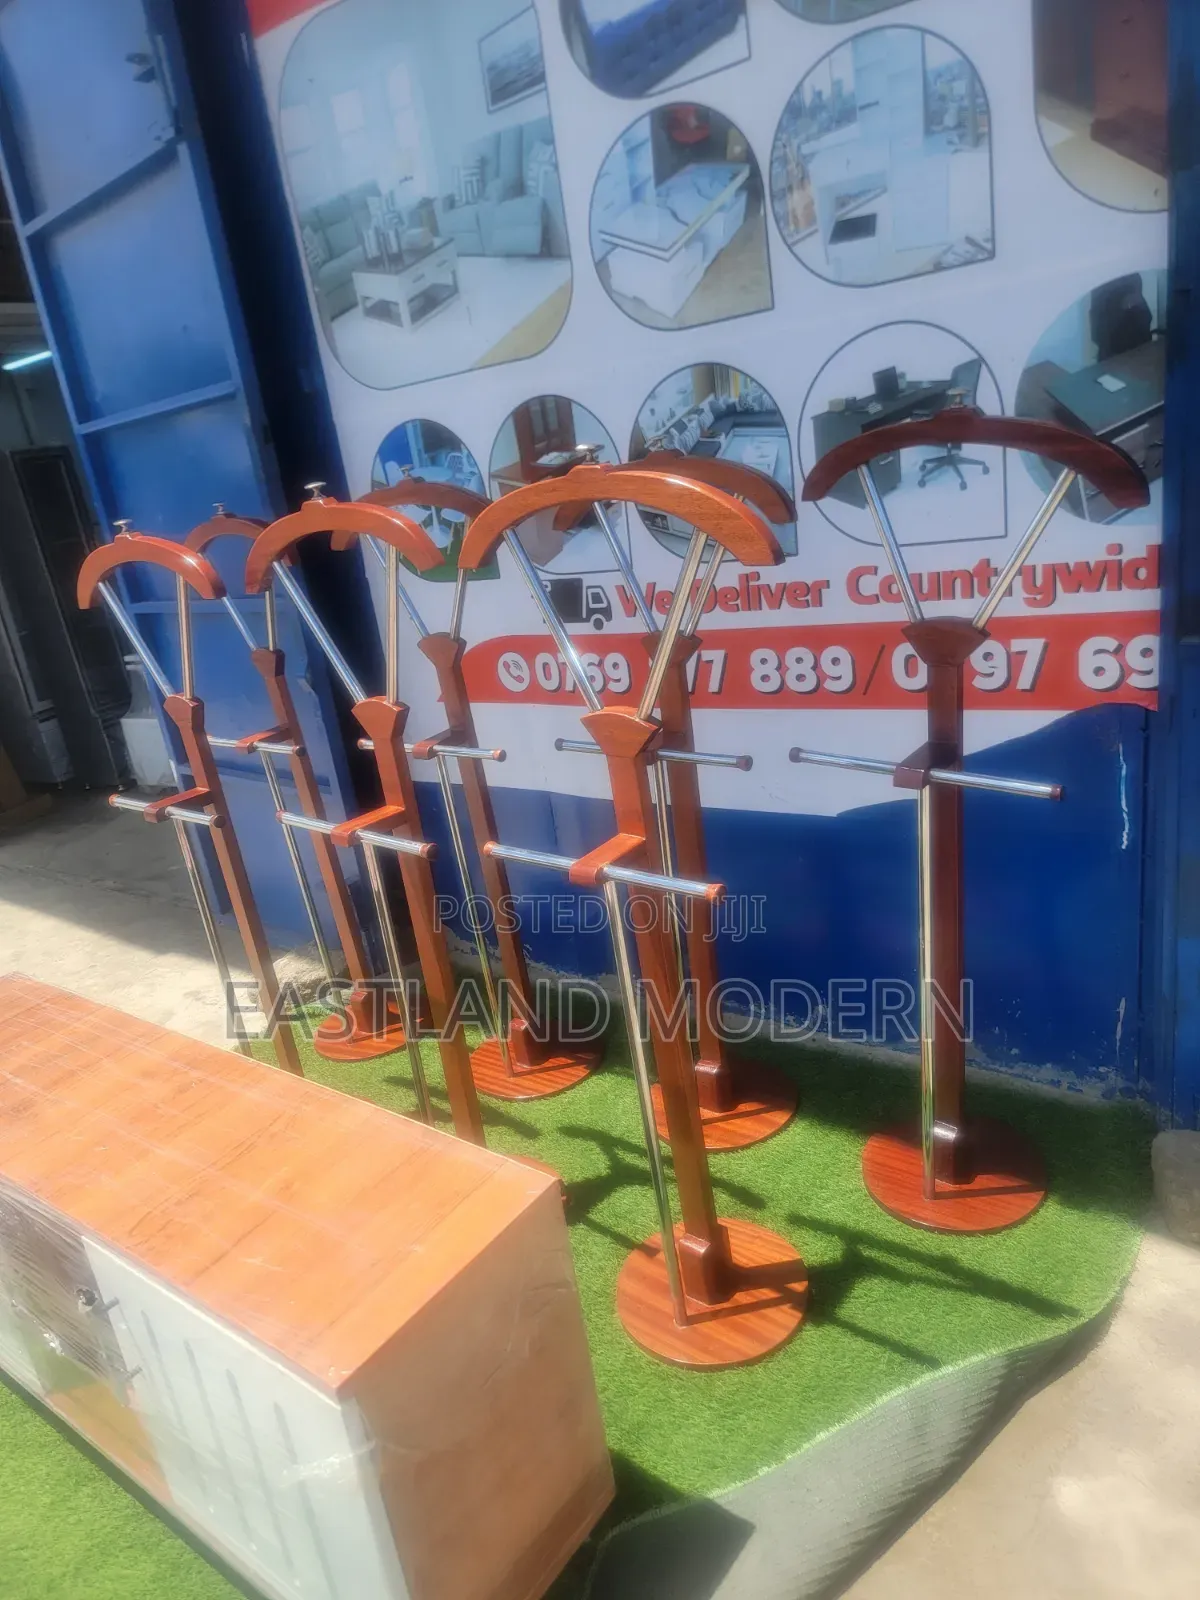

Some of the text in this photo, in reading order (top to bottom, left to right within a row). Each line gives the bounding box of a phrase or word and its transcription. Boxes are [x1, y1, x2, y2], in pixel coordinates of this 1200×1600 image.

[615, 582, 674, 618] We
[691, 571, 830, 614] Deliver
[750, 645, 856, 694] 889
[891, 638, 1049, 692] 097
